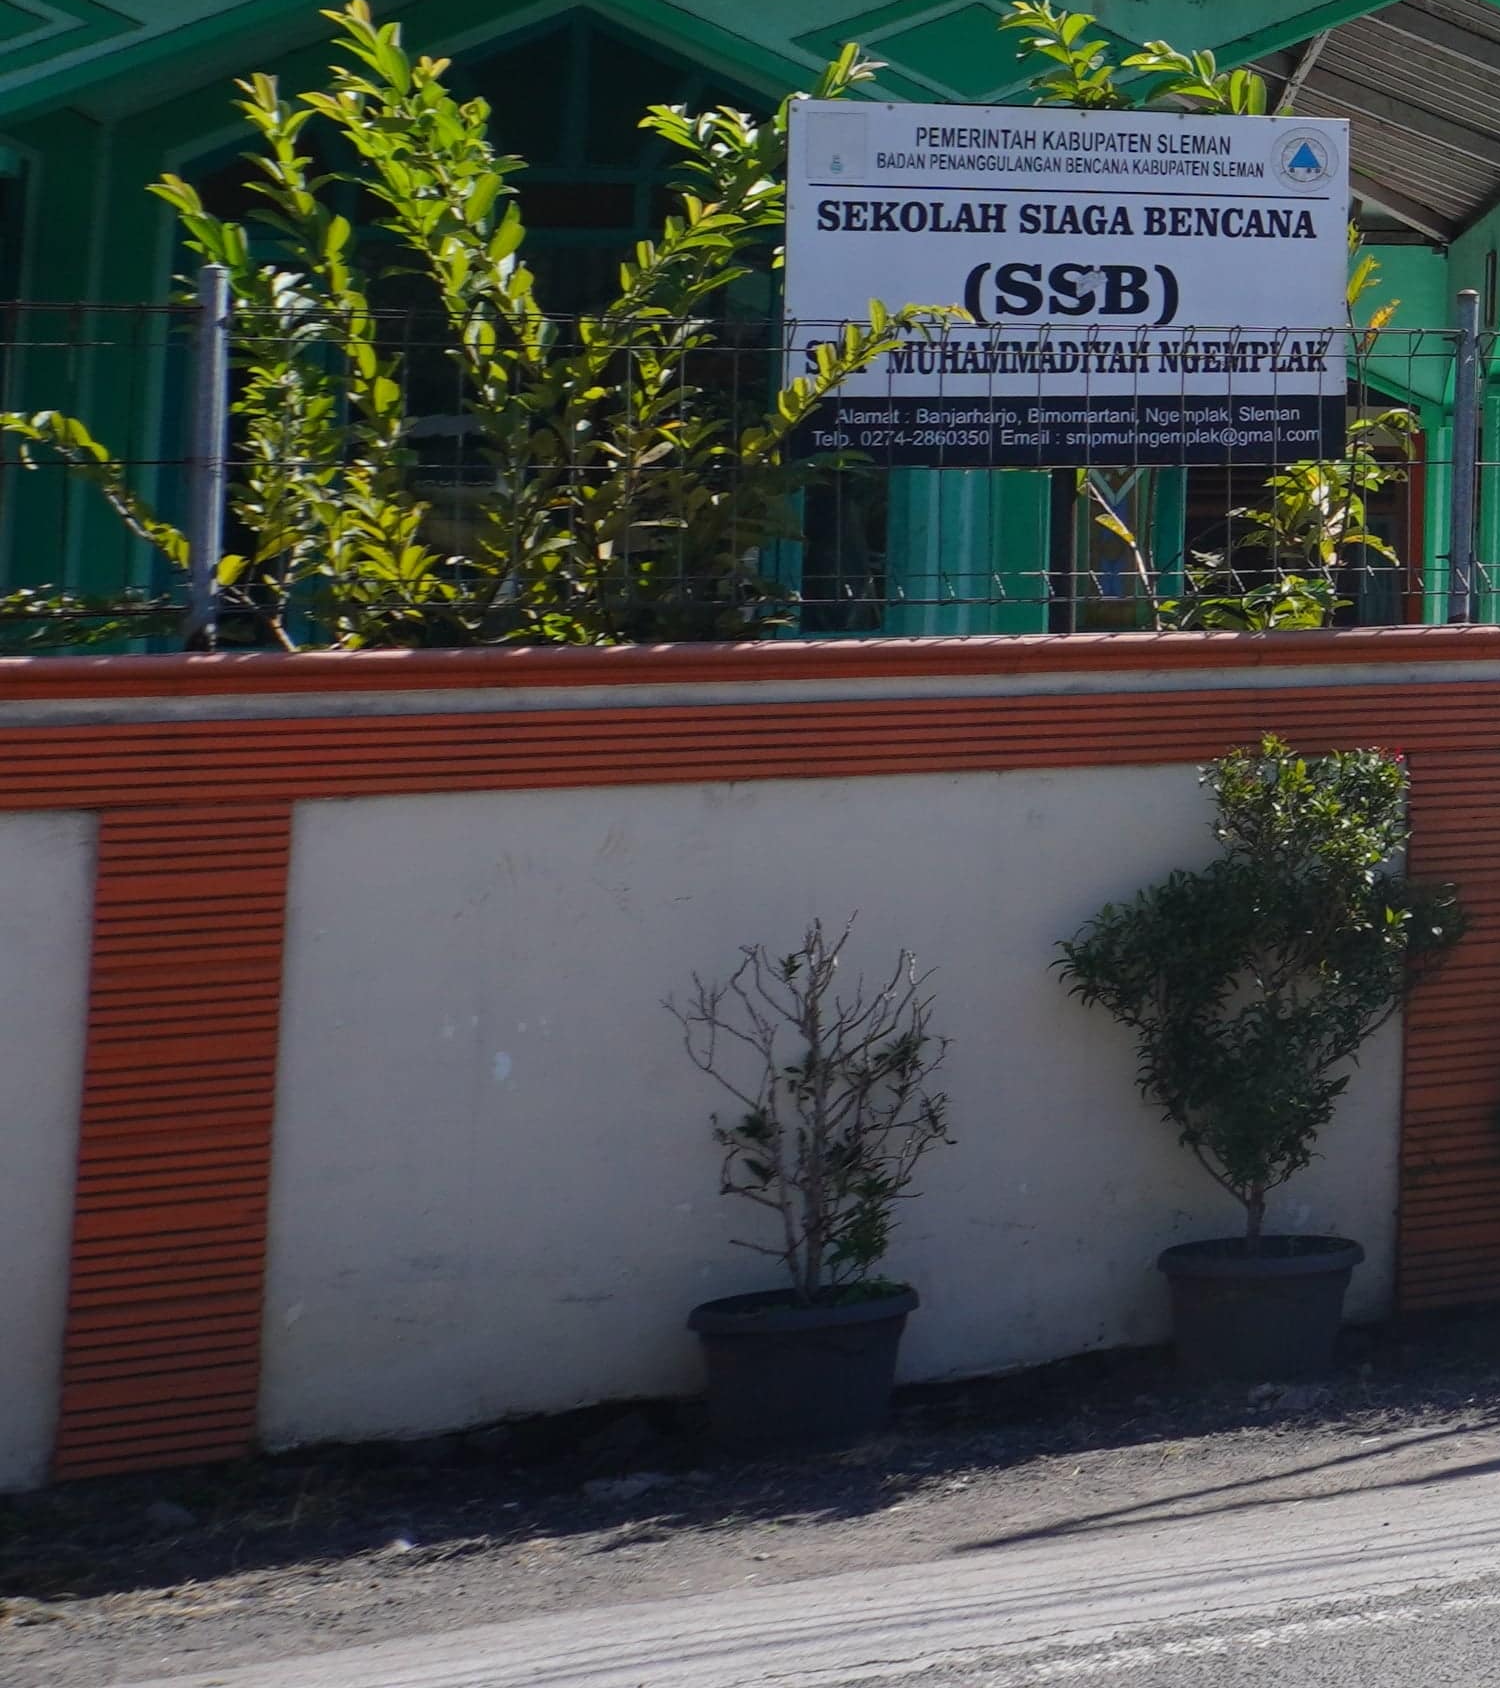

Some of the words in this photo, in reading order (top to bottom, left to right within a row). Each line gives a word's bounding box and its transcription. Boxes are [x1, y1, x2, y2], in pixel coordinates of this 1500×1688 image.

[916, 127, 1036, 150] PEMERINTAH
[1042, 130, 1151, 153] KABUPATEN
[1157, 134, 1231, 155] SLEMAN
[877, 152, 925, 169] BADAN
[930, 153, 1061, 173] PENANGGULANGAN
[1066, 157, 1129, 175] BENCANA
[1132, 159, 1209, 177] KABUPATEN
[1212, 162, 1264, 178] SLEMAN
[817, 200, 1007, 232] SEKOLAH
[1019, 203, 1134, 236] SIAGA
[1143, 206, 1317, 239] BENCANA
[963, 263, 1180, 326] (SSB)
[886, 339, 1149, 375] MUHAMMADIYAH
[1158, 340, 1327, 374] NGEMPLAK
[835, 408, 899, 424] Alamat
[917, 408, 1022, 427] Banjarharjo,
[1239, 406, 1300, 422] Sleman
[860, 430, 989, 446] 0274-2860350
[1000, 429, 1050, 446] Email
[1066, 427, 1320, 447] smpmuhngemplak@gmal.com
